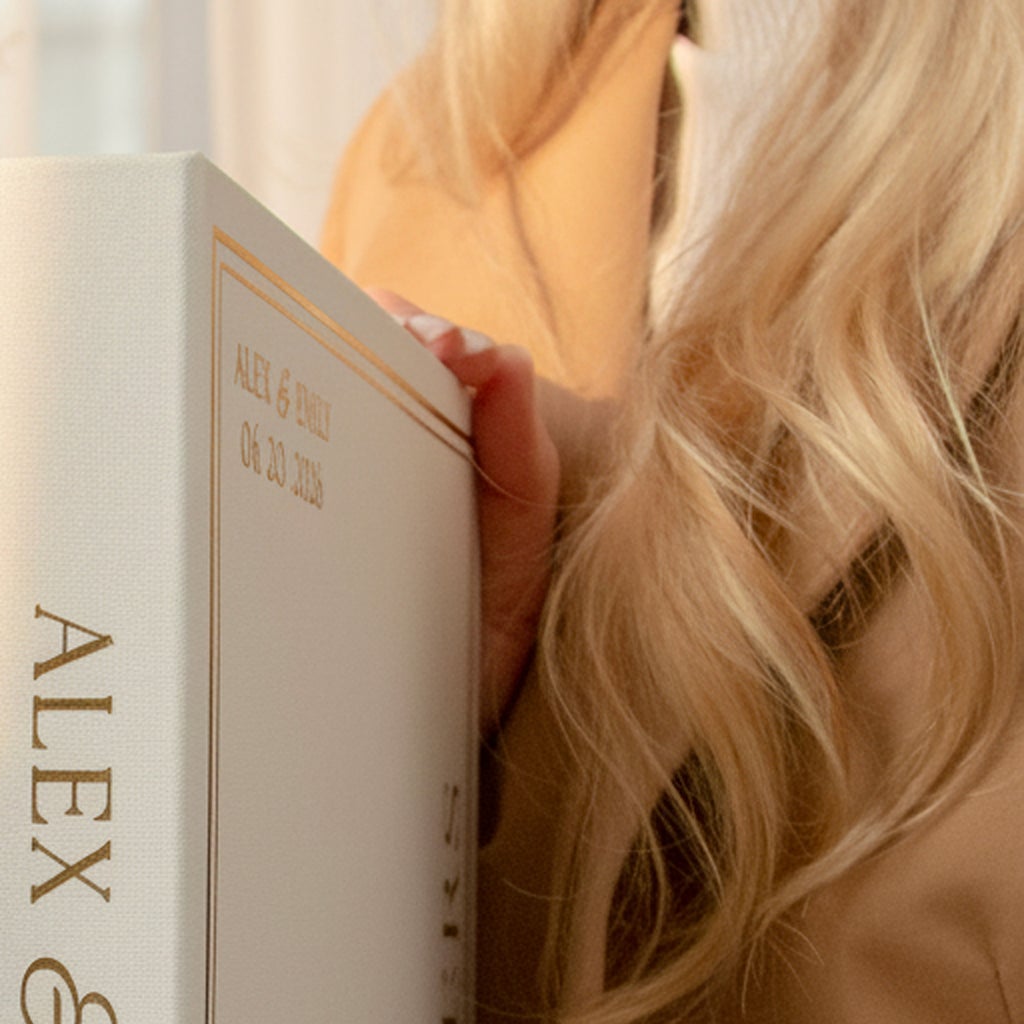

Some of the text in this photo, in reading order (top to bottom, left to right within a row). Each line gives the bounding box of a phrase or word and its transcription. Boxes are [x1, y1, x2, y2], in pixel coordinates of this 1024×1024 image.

[234, 342, 272, 406] ALEX
[277, 367, 291, 419] &
[30, 603, 115, 905] ALEX
